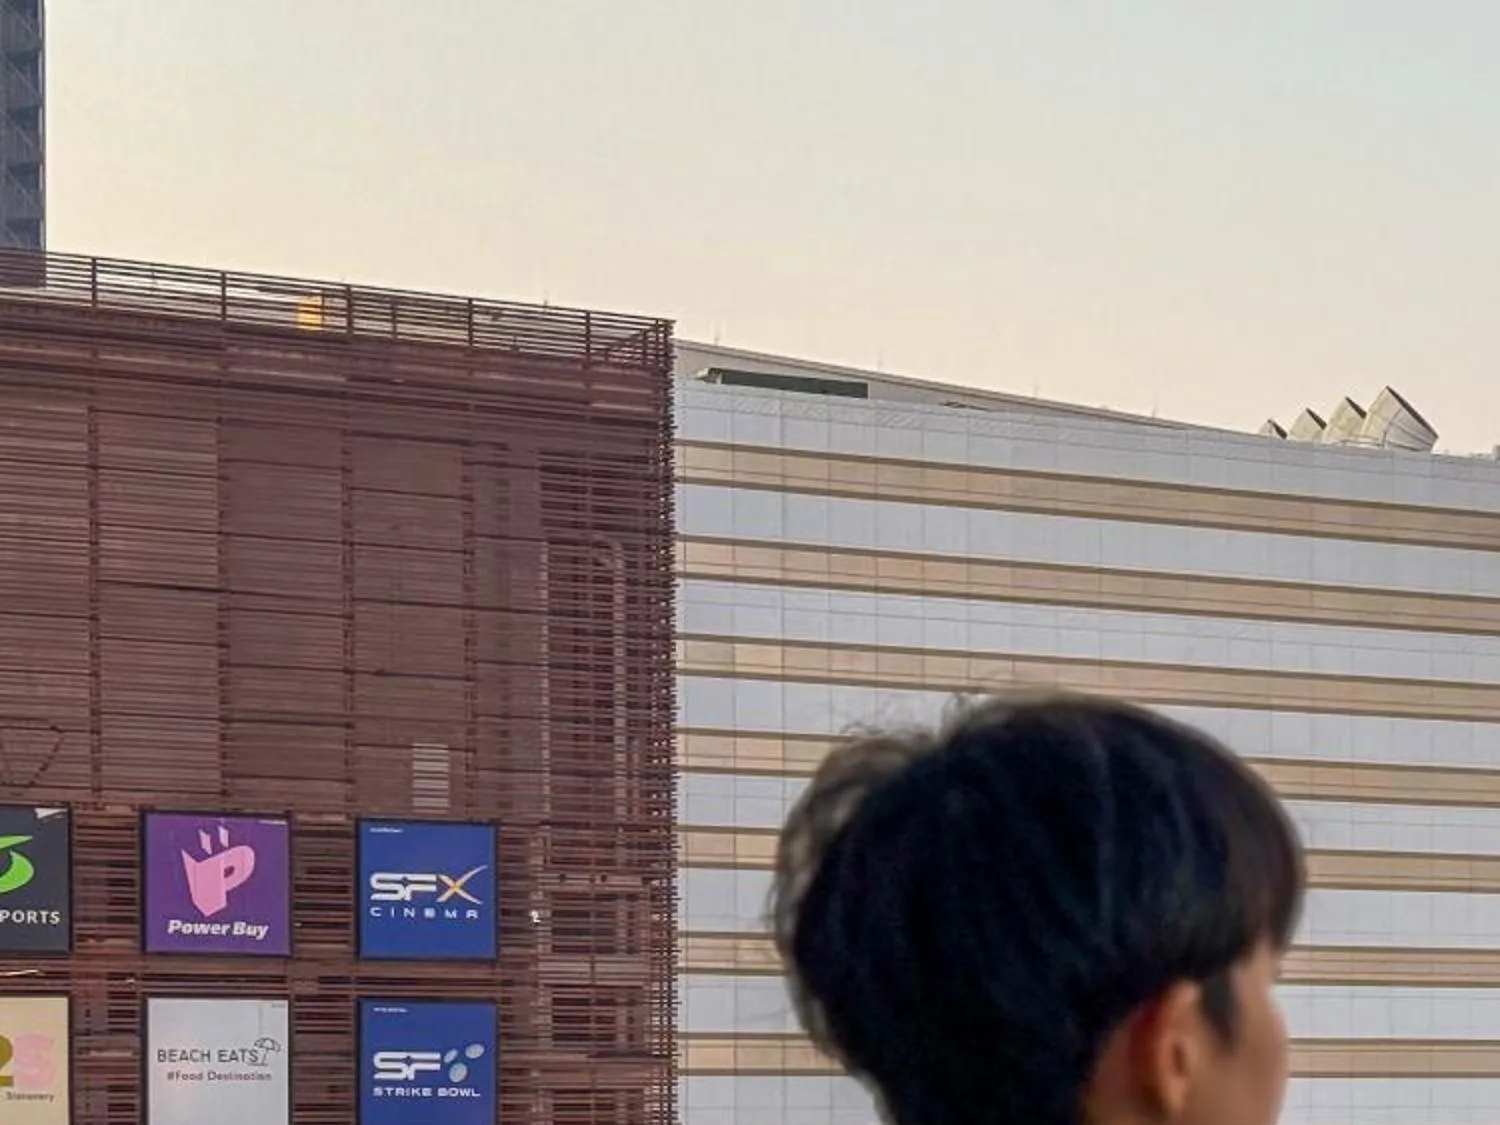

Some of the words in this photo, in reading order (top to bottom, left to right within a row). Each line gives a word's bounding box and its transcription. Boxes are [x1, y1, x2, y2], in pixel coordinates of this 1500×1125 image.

[370, 864, 488, 905] SFX
[369, 906, 479, 919] CINEMA
[167, 919, 231, 936] Power
[232, 921, 270, 940] Buy
[157, 1048, 211, 1063] BEACH
[217, 1049, 259, 1063] EATS
[373, 1051, 441, 1080] SF
[373, 1087, 432, 1097] STRIKE
[437, 1087, 481, 1097] BOWL
